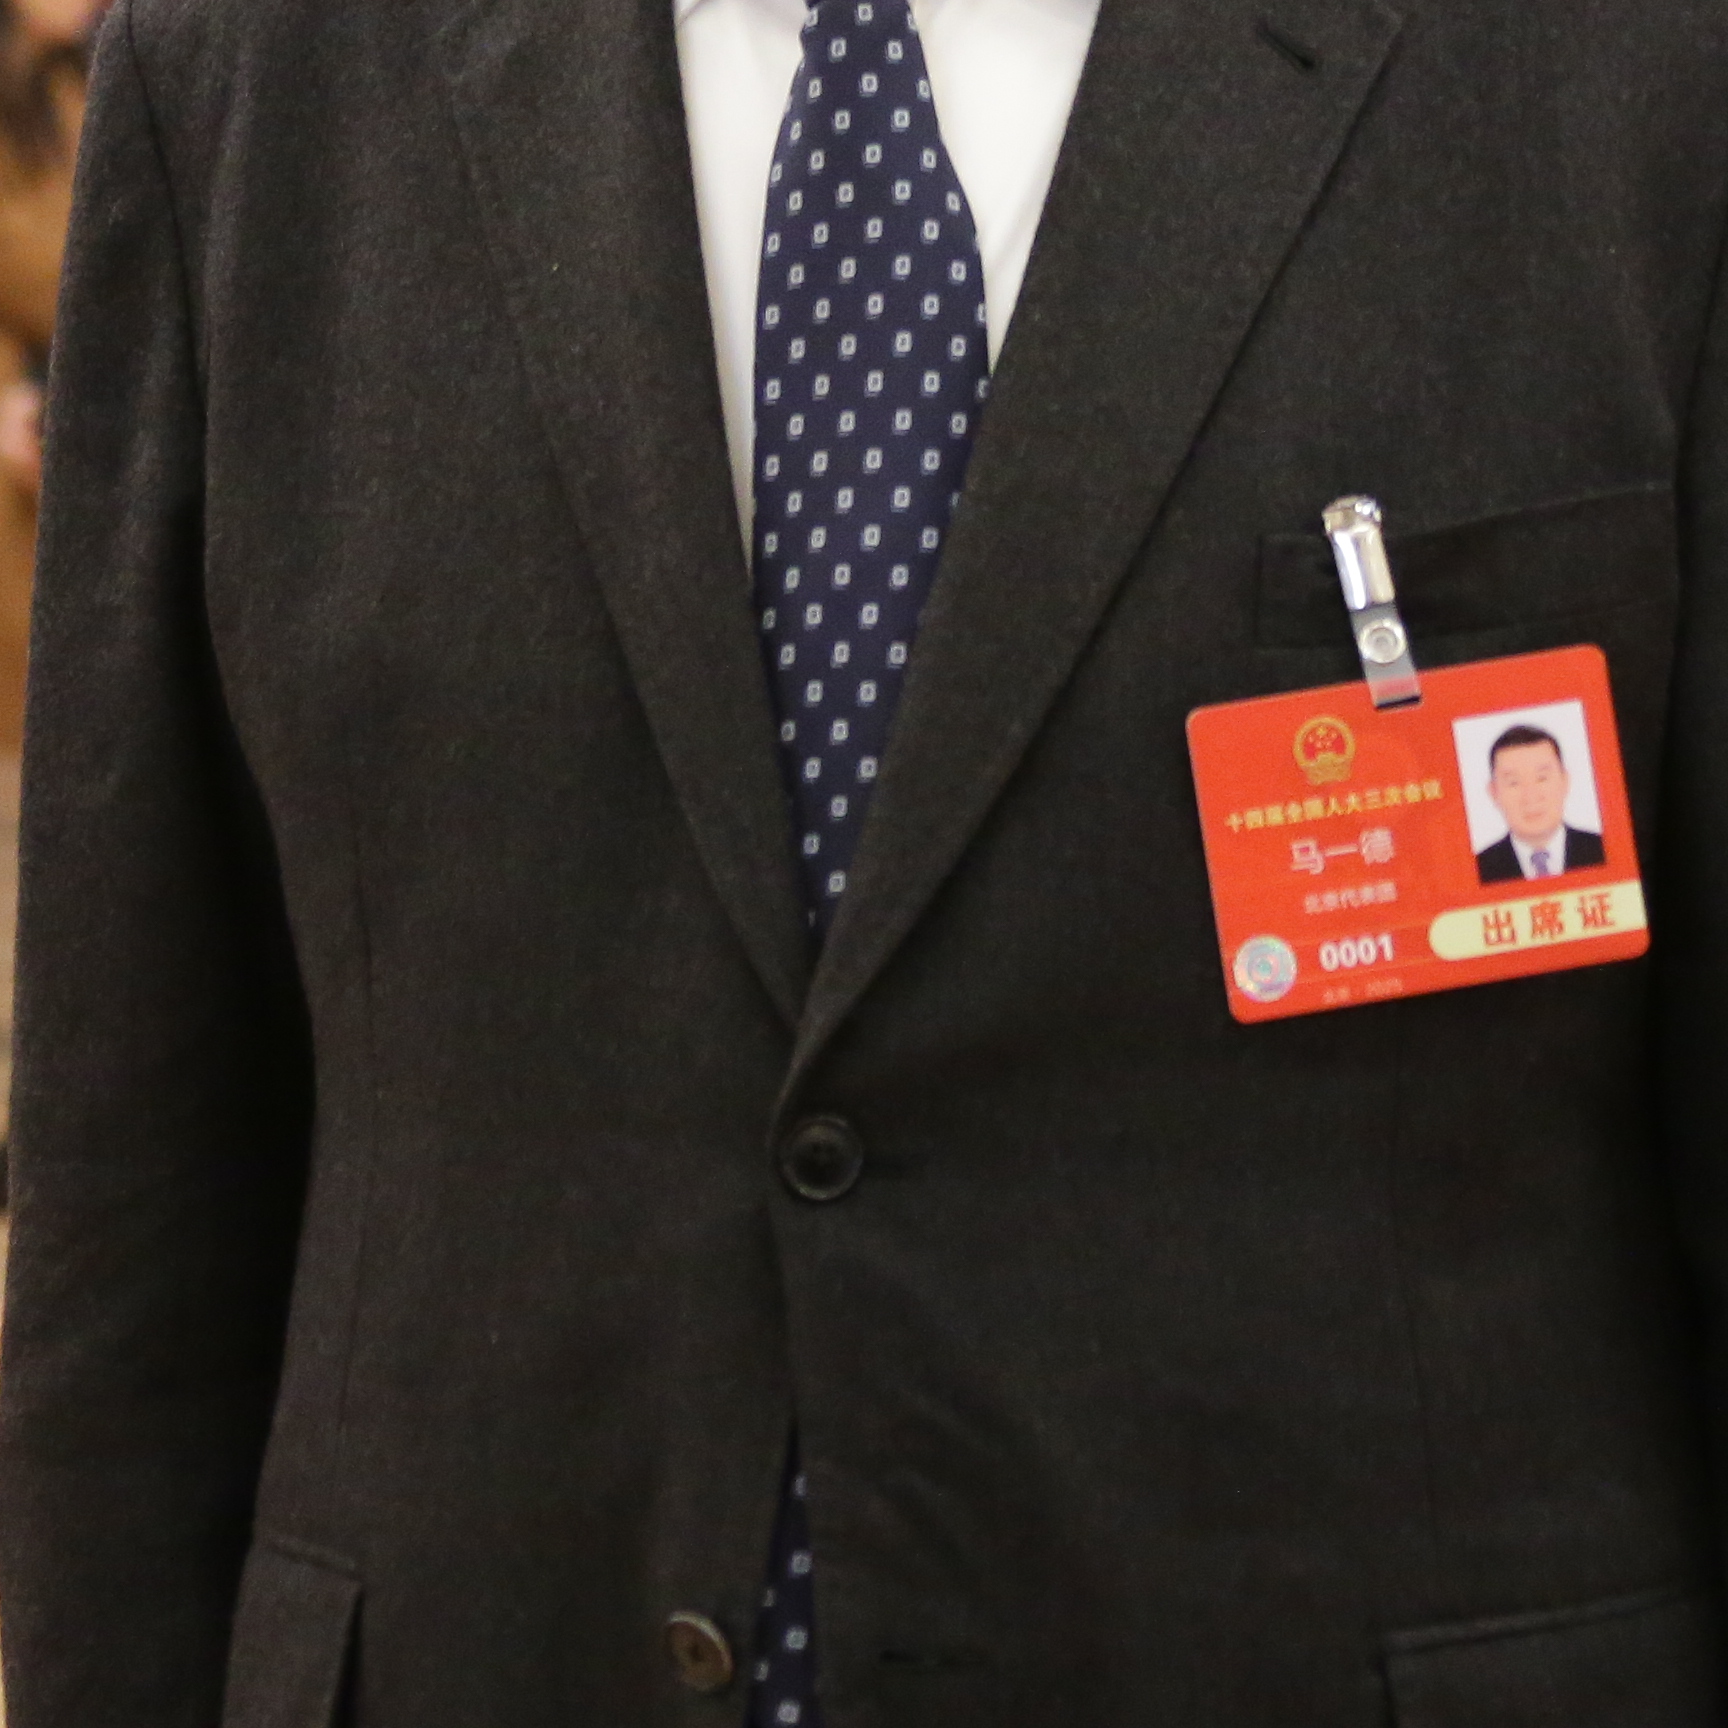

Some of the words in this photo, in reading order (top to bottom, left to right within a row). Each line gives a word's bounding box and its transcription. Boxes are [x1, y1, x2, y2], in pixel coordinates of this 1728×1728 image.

[1290, 827, 1395, 875] 马一德
[1482, 892, 1616, 947] 出席证
[1319, 933, 1394, 972] 0001
